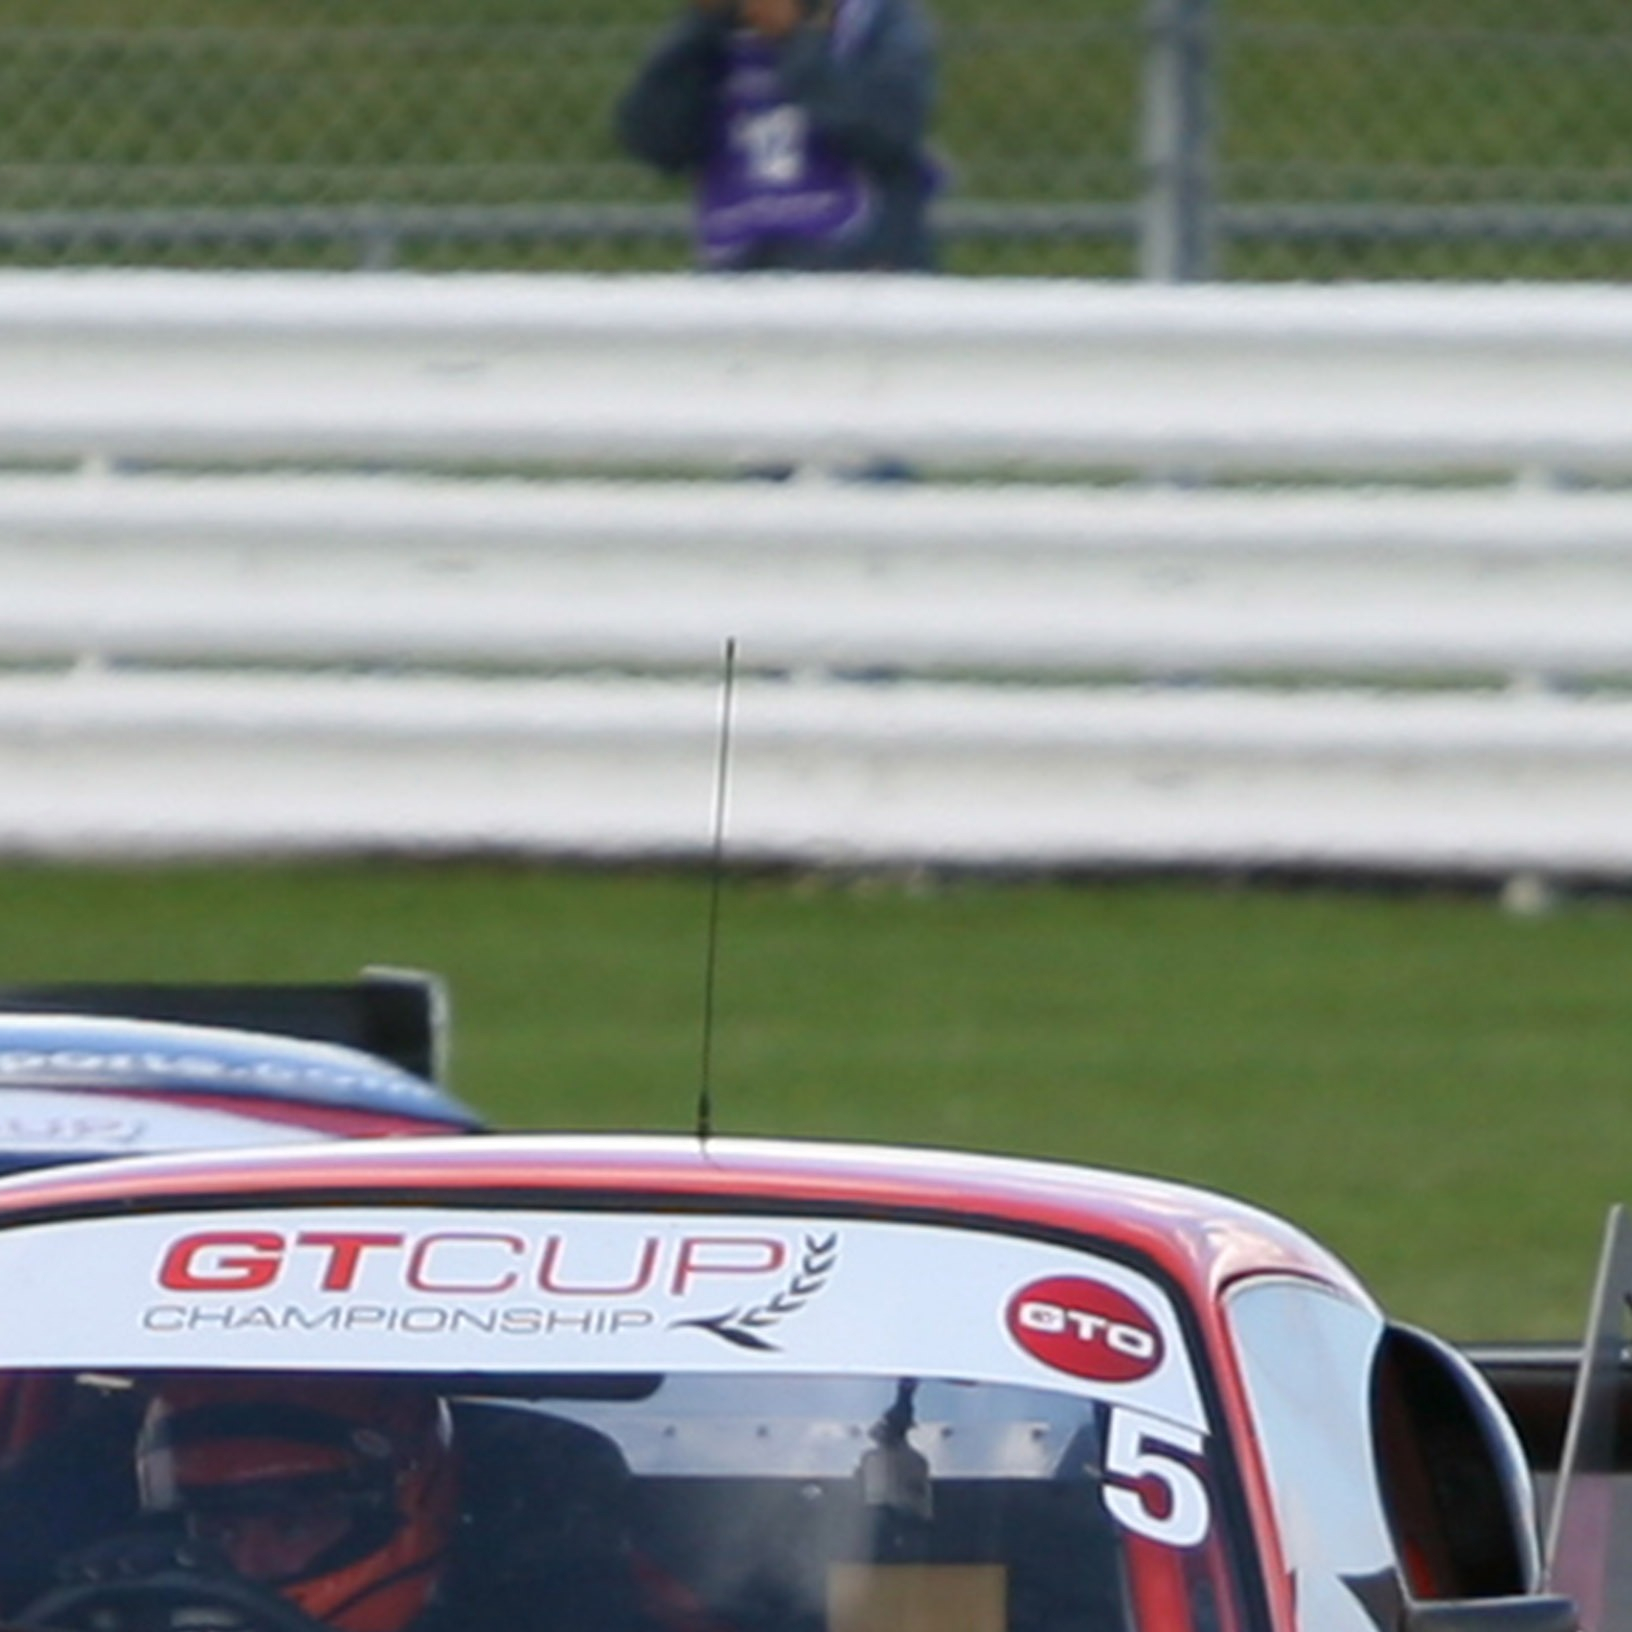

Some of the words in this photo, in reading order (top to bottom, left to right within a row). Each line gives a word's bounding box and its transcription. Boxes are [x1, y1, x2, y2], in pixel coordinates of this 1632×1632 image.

[142, 1303, 655, 1335] CHAMPIONSHIP
[1019, 1301, 1155, 1359] GTO
[1101, 1405, 1211, 1547] 5
